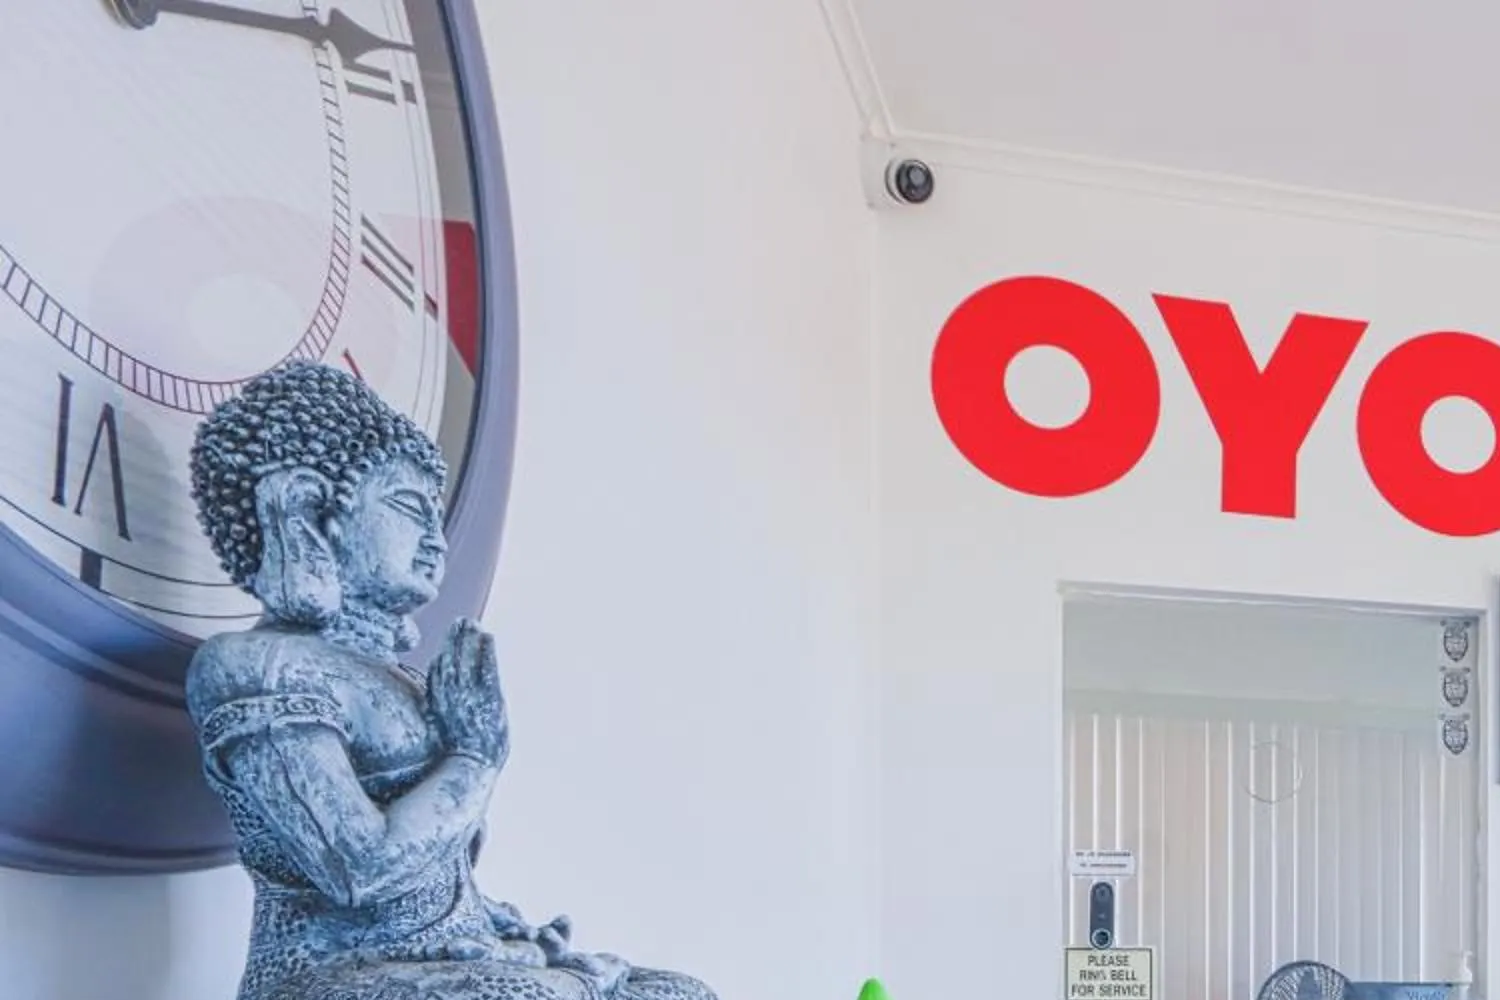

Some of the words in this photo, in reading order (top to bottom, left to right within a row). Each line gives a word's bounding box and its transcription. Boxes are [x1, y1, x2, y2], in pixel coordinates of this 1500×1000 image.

[1088, 954, 1129, 967] PLEASE
[1111, 969, 1137, 981] BELL
[1071, 984, 1095, 997] FOR
[1100, 984, 1147, 997] SERVICE
